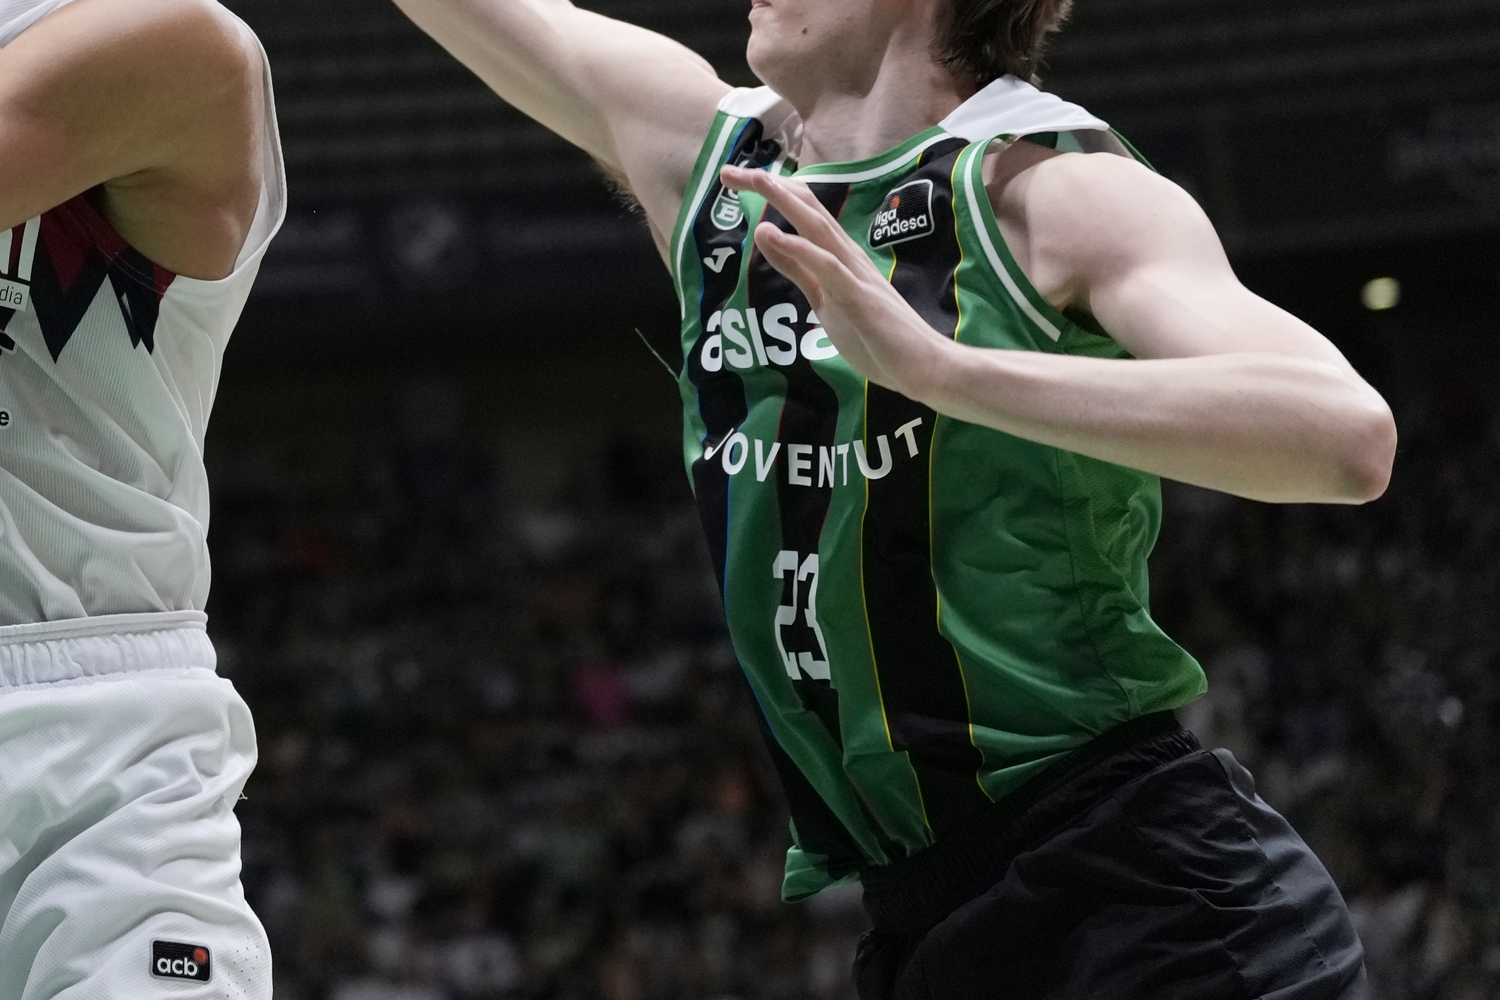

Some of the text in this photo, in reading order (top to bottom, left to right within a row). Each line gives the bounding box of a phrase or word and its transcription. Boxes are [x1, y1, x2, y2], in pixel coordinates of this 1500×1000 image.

[873, 214, 927, 240] endesa
[875, 209, 897, 226] liga
[772, 550, 831, 680] 23
[157, 957, 198, 976] acb
